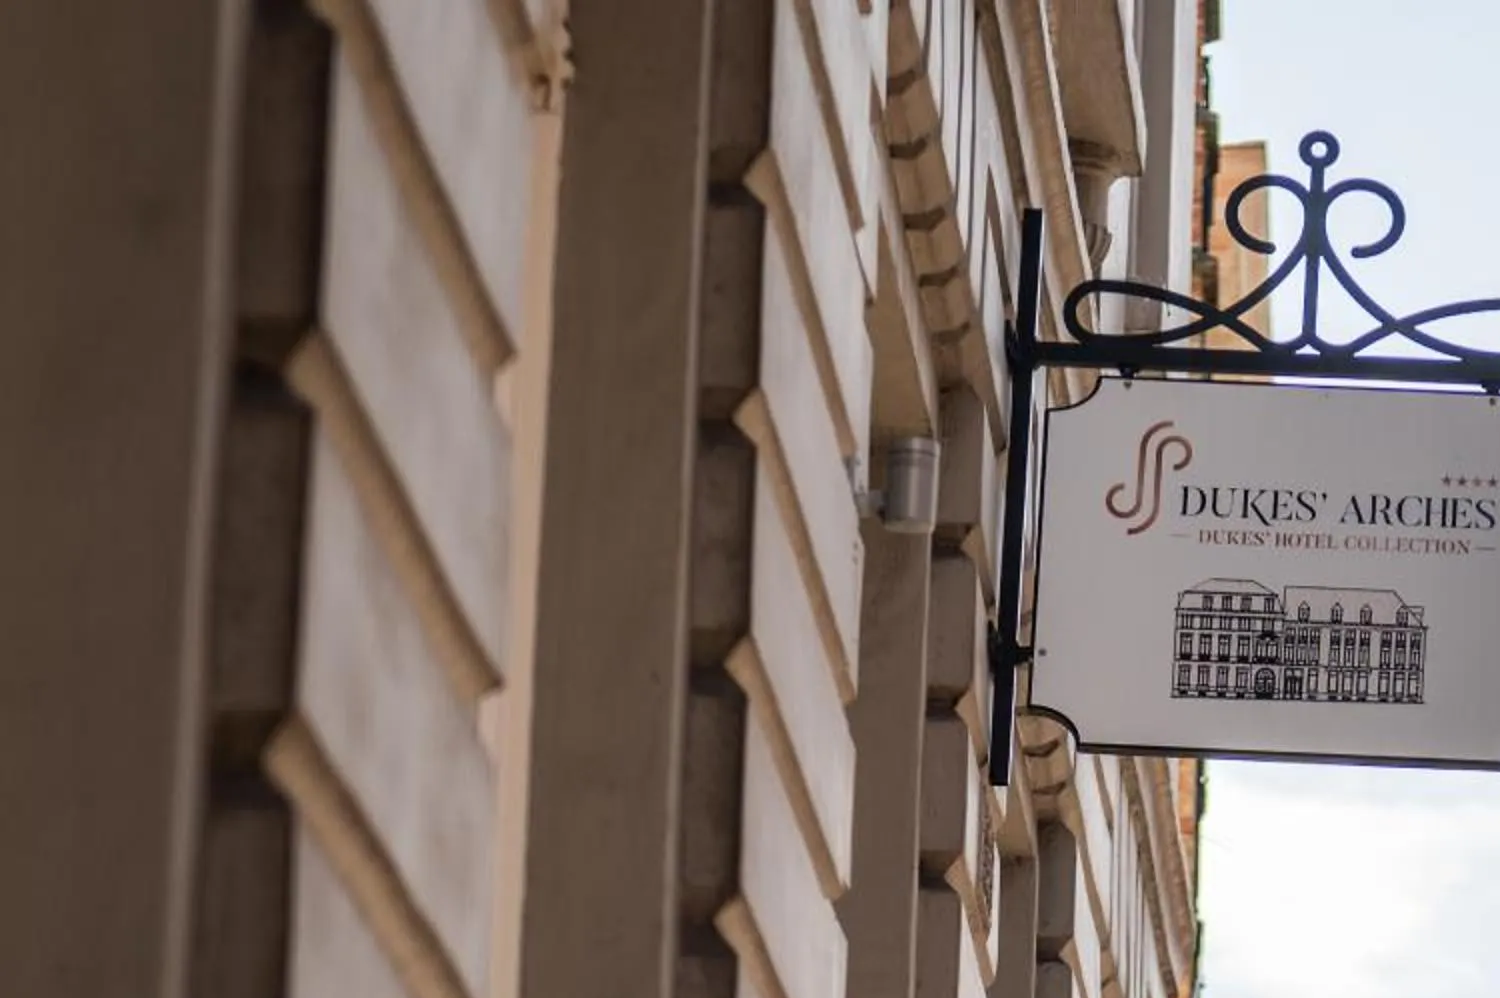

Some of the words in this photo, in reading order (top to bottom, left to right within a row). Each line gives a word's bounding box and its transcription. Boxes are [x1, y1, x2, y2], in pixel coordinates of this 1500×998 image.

[1180, 485, 1328, 527] DUKES'
[1339, 493, 1497, 530] ARCHES
[1275, 532, 1338, 550] HOTEL
[1343, 534, 1472, 555] COLLECTION
